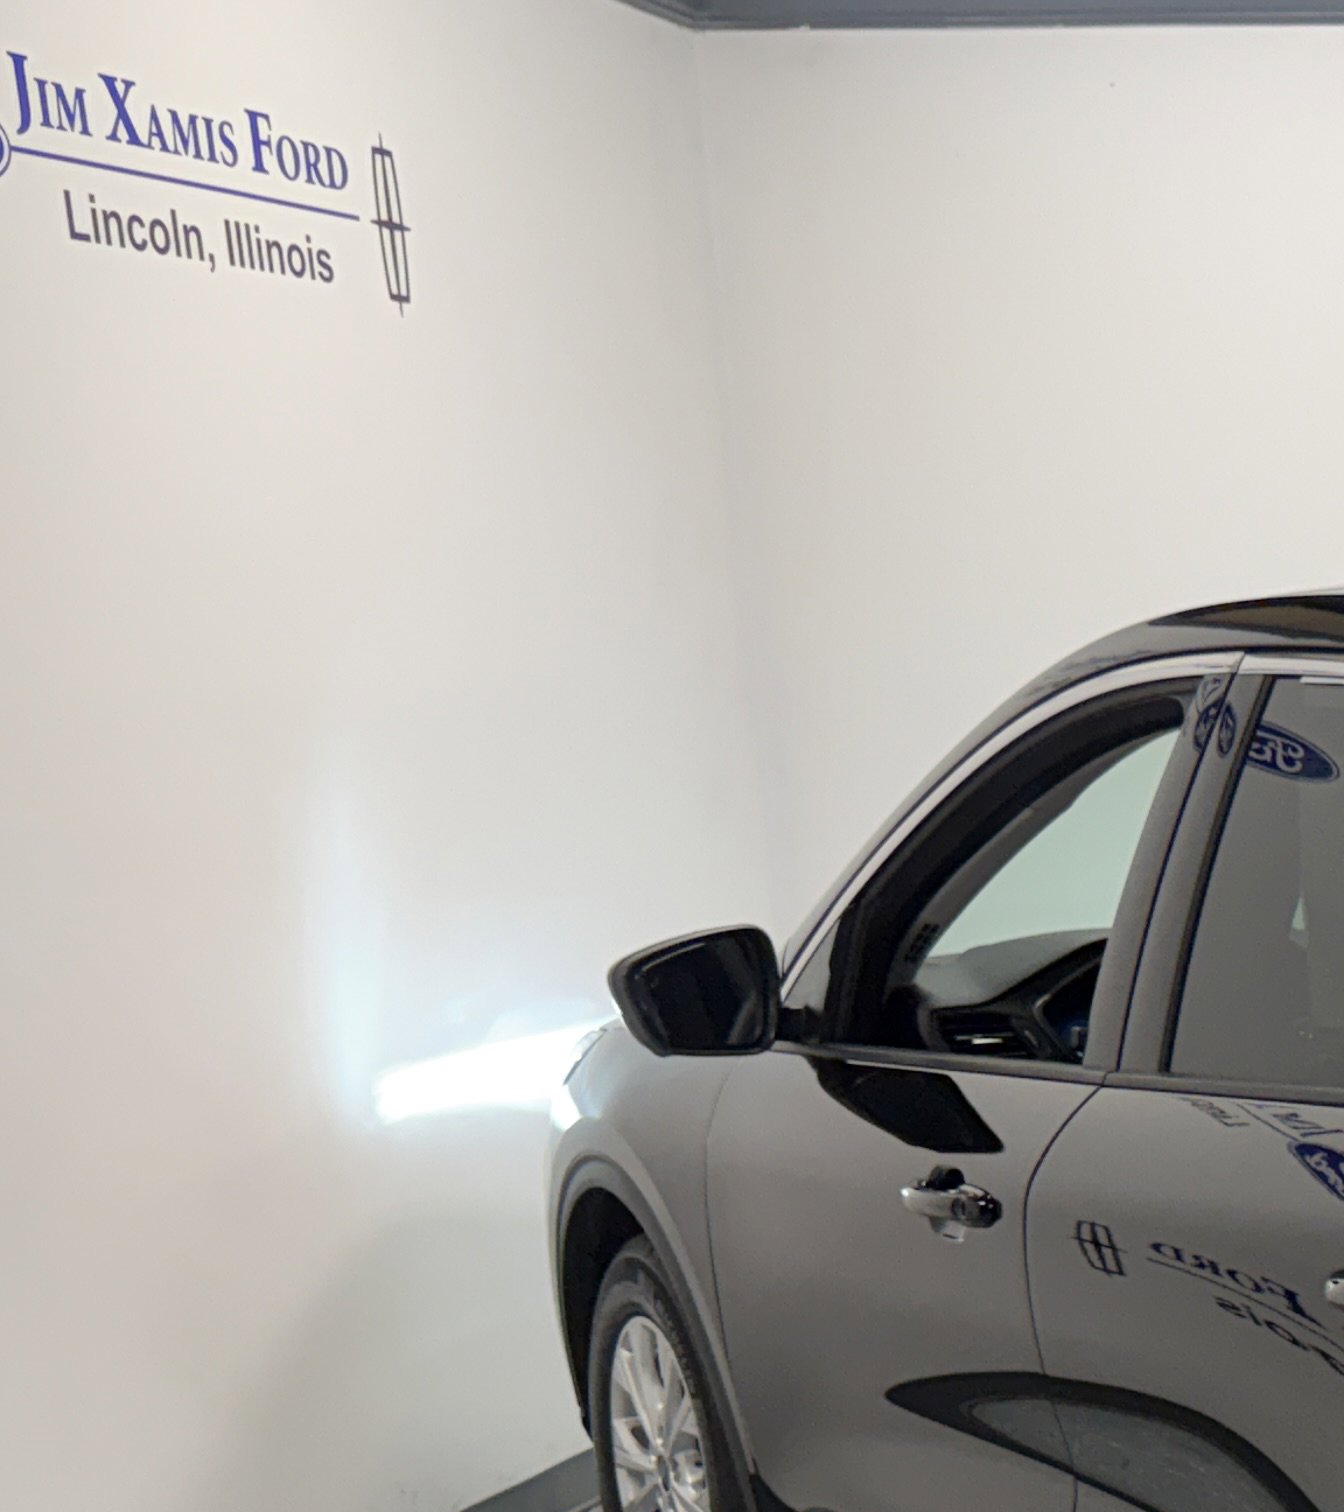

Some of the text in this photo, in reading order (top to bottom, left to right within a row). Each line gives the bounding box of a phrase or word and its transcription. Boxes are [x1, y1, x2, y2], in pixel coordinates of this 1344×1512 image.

[6, 50, 349, 191] JIM XAMIS FORD
[63, 189, 335, 283] Lincoln, Illinois
